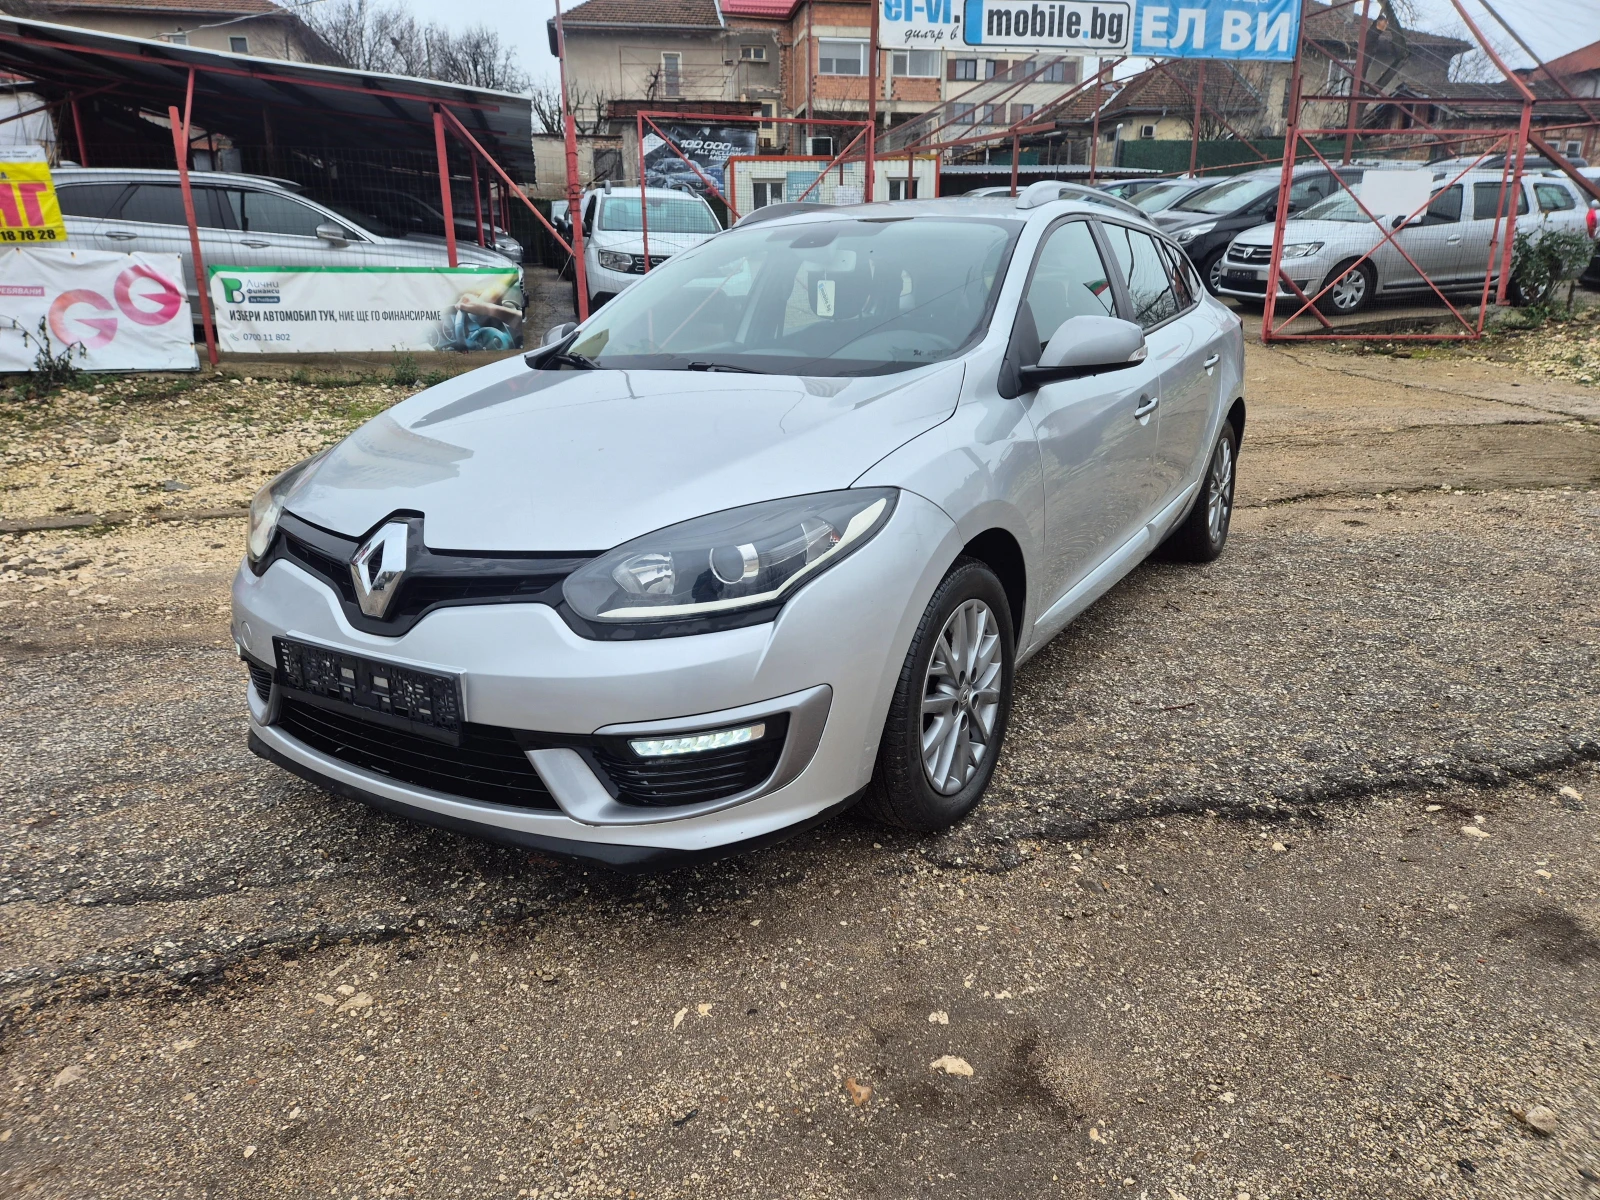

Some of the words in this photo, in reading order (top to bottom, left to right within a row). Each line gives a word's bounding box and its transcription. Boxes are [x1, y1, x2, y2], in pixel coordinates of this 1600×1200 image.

[987, 4, 1123, 43] mobile.bg
[1141, 6, 1206, 49] ЕЛ
[1220, 10, 1290, 52] ВИ
[904, 28, 944, 43] дилър
[680, 139, 702, 149] 100
[703, 142, 731, 151] 000
[18, 230, 35, 240] 78
[38, 229, 56, 239] 28
[246, 279, 280, 288] Лични
[0, 287, 42, 295] ЕБЯВАНИ
[229, 310, 260, 322] ИЗБЕРИ
[263, 310, 317, 322] АВТОМОБИЛ
[318, 310, 338, 322] ТУК,
[339, 310, 355, 321] НИЕ
[356, 310, 370, 322] ЩЕ
[371, 310, 380, 321] ГО
[381, 310, 441, 321] ФИНАНСИРАМЕ
[243, 333, 262, 341] 0700
[264, 333, 273, 341] 11
[275, 333, 291, 341] 802
